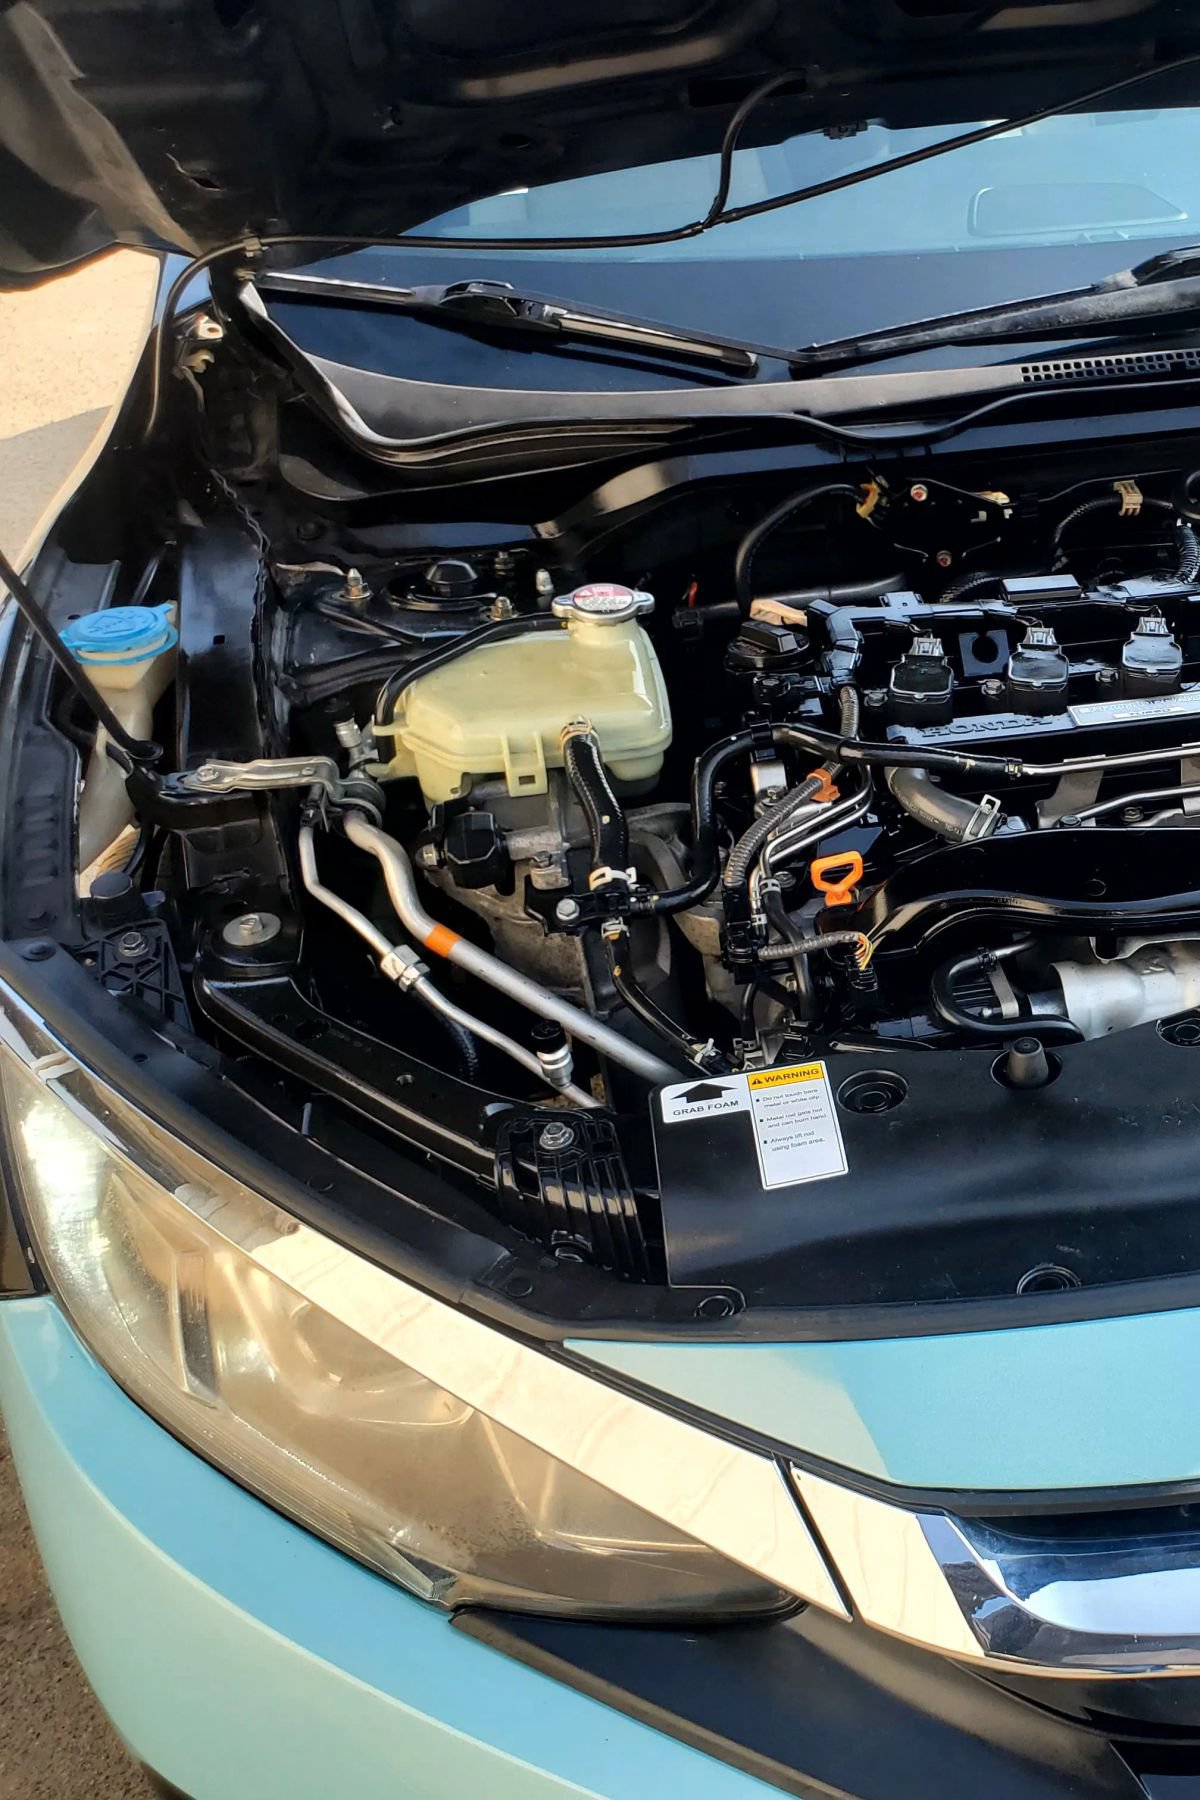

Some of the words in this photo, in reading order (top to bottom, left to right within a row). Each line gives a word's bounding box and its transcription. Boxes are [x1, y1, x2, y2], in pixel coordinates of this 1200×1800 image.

[919, 716, 1053, 738] HONDA
[763, 1067, 820, 1083] WARNING
[672, 1105, 705, 1117] GRAB
[708, 1100, 739, 1111] FOAM
[767, 1121, 780, 1129] and
[770, 1135, 794, 1144] Always
[771, 1143, 790, 1152] using
[790, 1139, 808, 1148] foam
